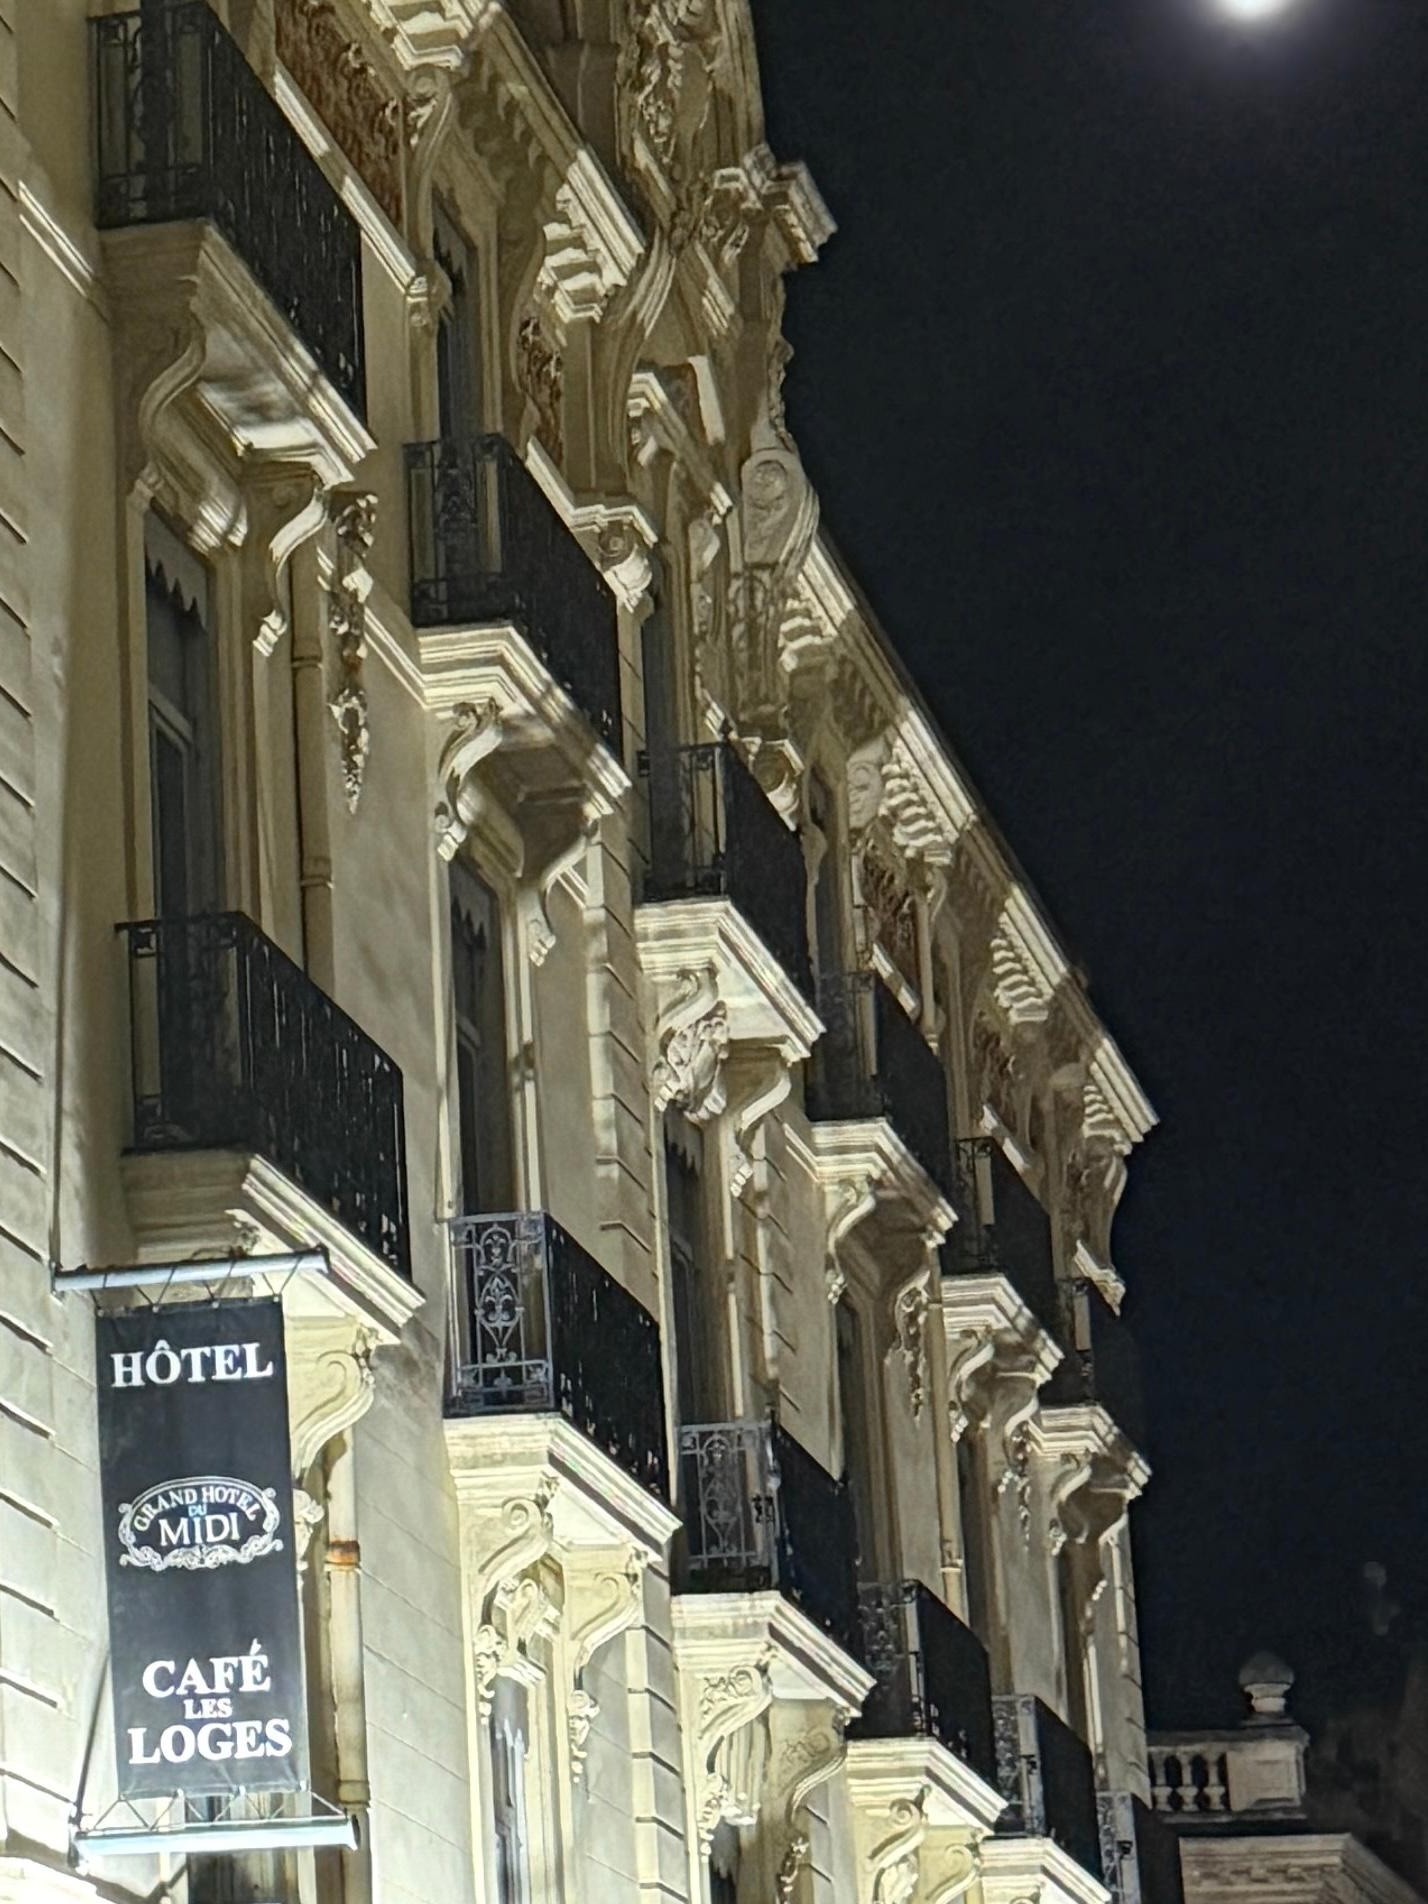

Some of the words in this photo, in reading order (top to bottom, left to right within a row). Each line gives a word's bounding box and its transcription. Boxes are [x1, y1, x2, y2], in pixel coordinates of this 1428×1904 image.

[110, 1339, 274, 1388] HÔTEL
[133, 1487, 198, 1532] GRAND
[201, 1485, 262, 1522] HOTEL
[158, 1512, 241, 1547] MIDI
[188, 1504, 208, 1517] DU
[142, 1637, 271, 1698] CAFÉ
[183, 1698, 233, 1719] LES
[127, 1718, 293, 1764] LOGES
